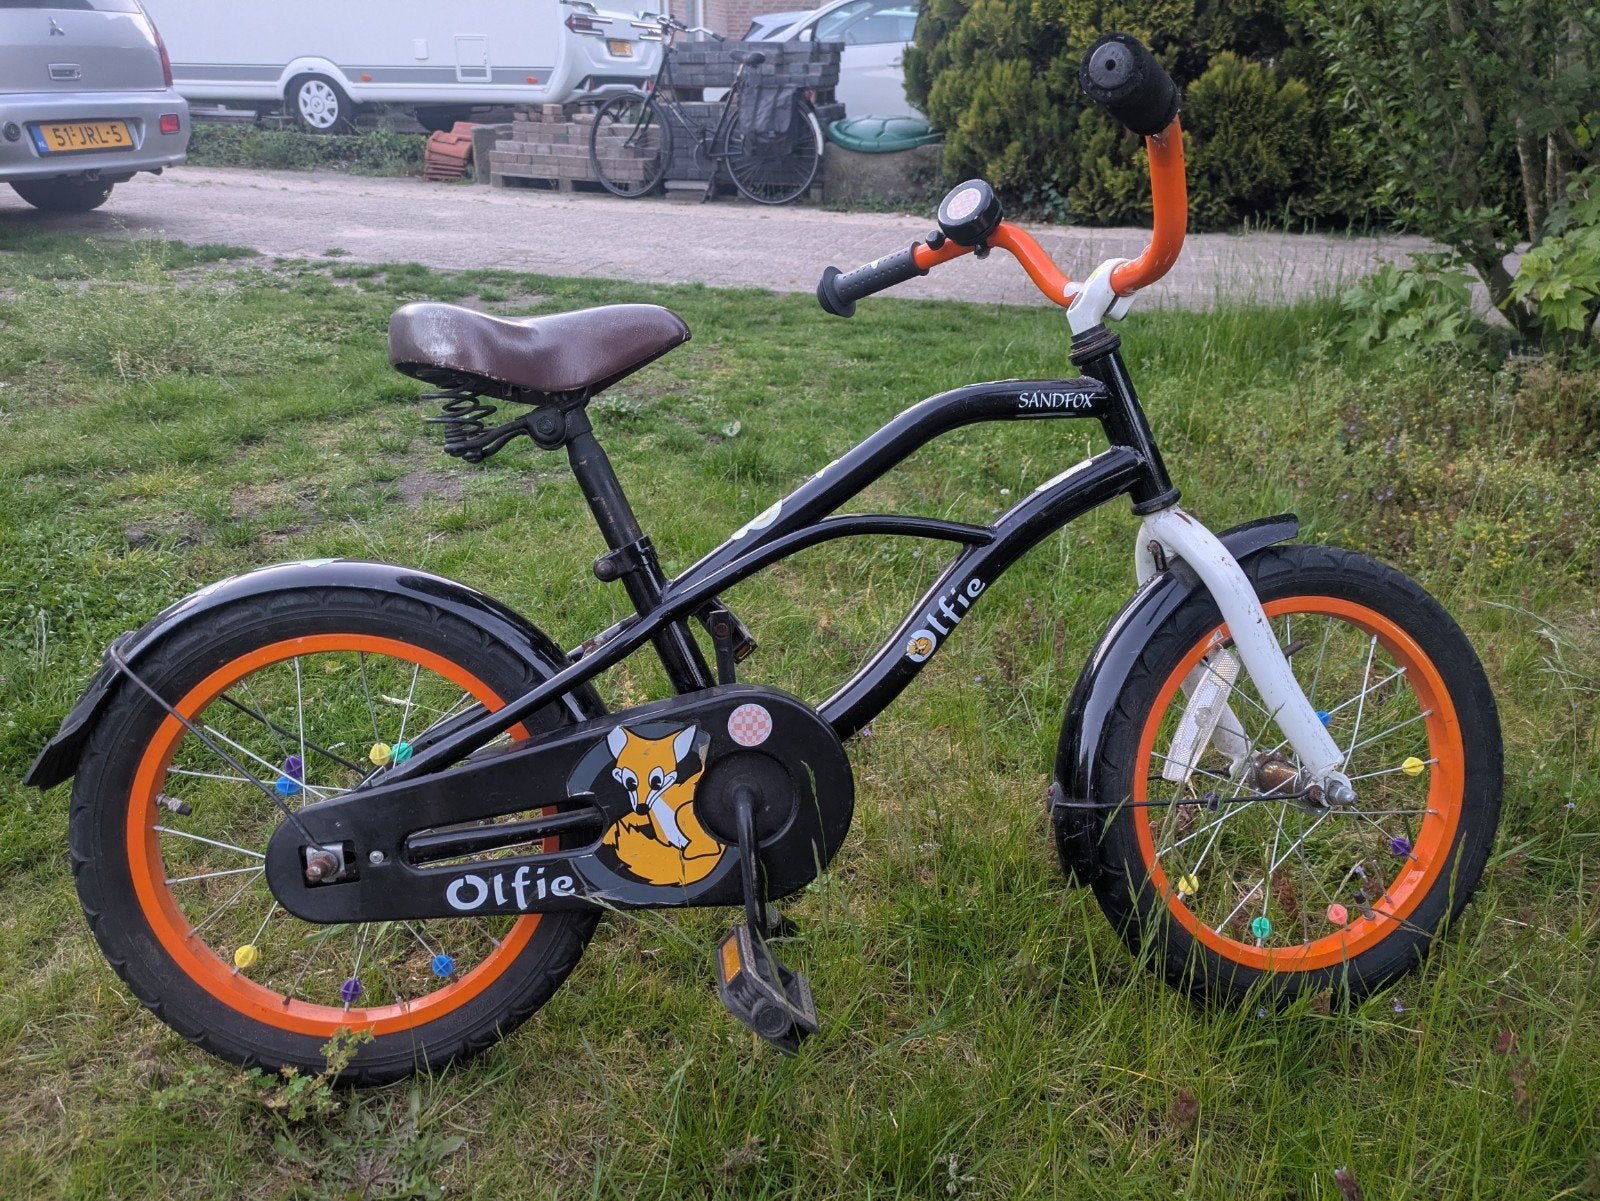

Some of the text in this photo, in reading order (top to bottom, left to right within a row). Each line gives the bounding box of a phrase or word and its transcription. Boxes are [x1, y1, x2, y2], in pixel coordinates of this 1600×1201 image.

[1018, 391, 1095, 409] SANDFOX
[906, 578, 986, 663] Olfie
[446, 865, 576, 911] Olfie
